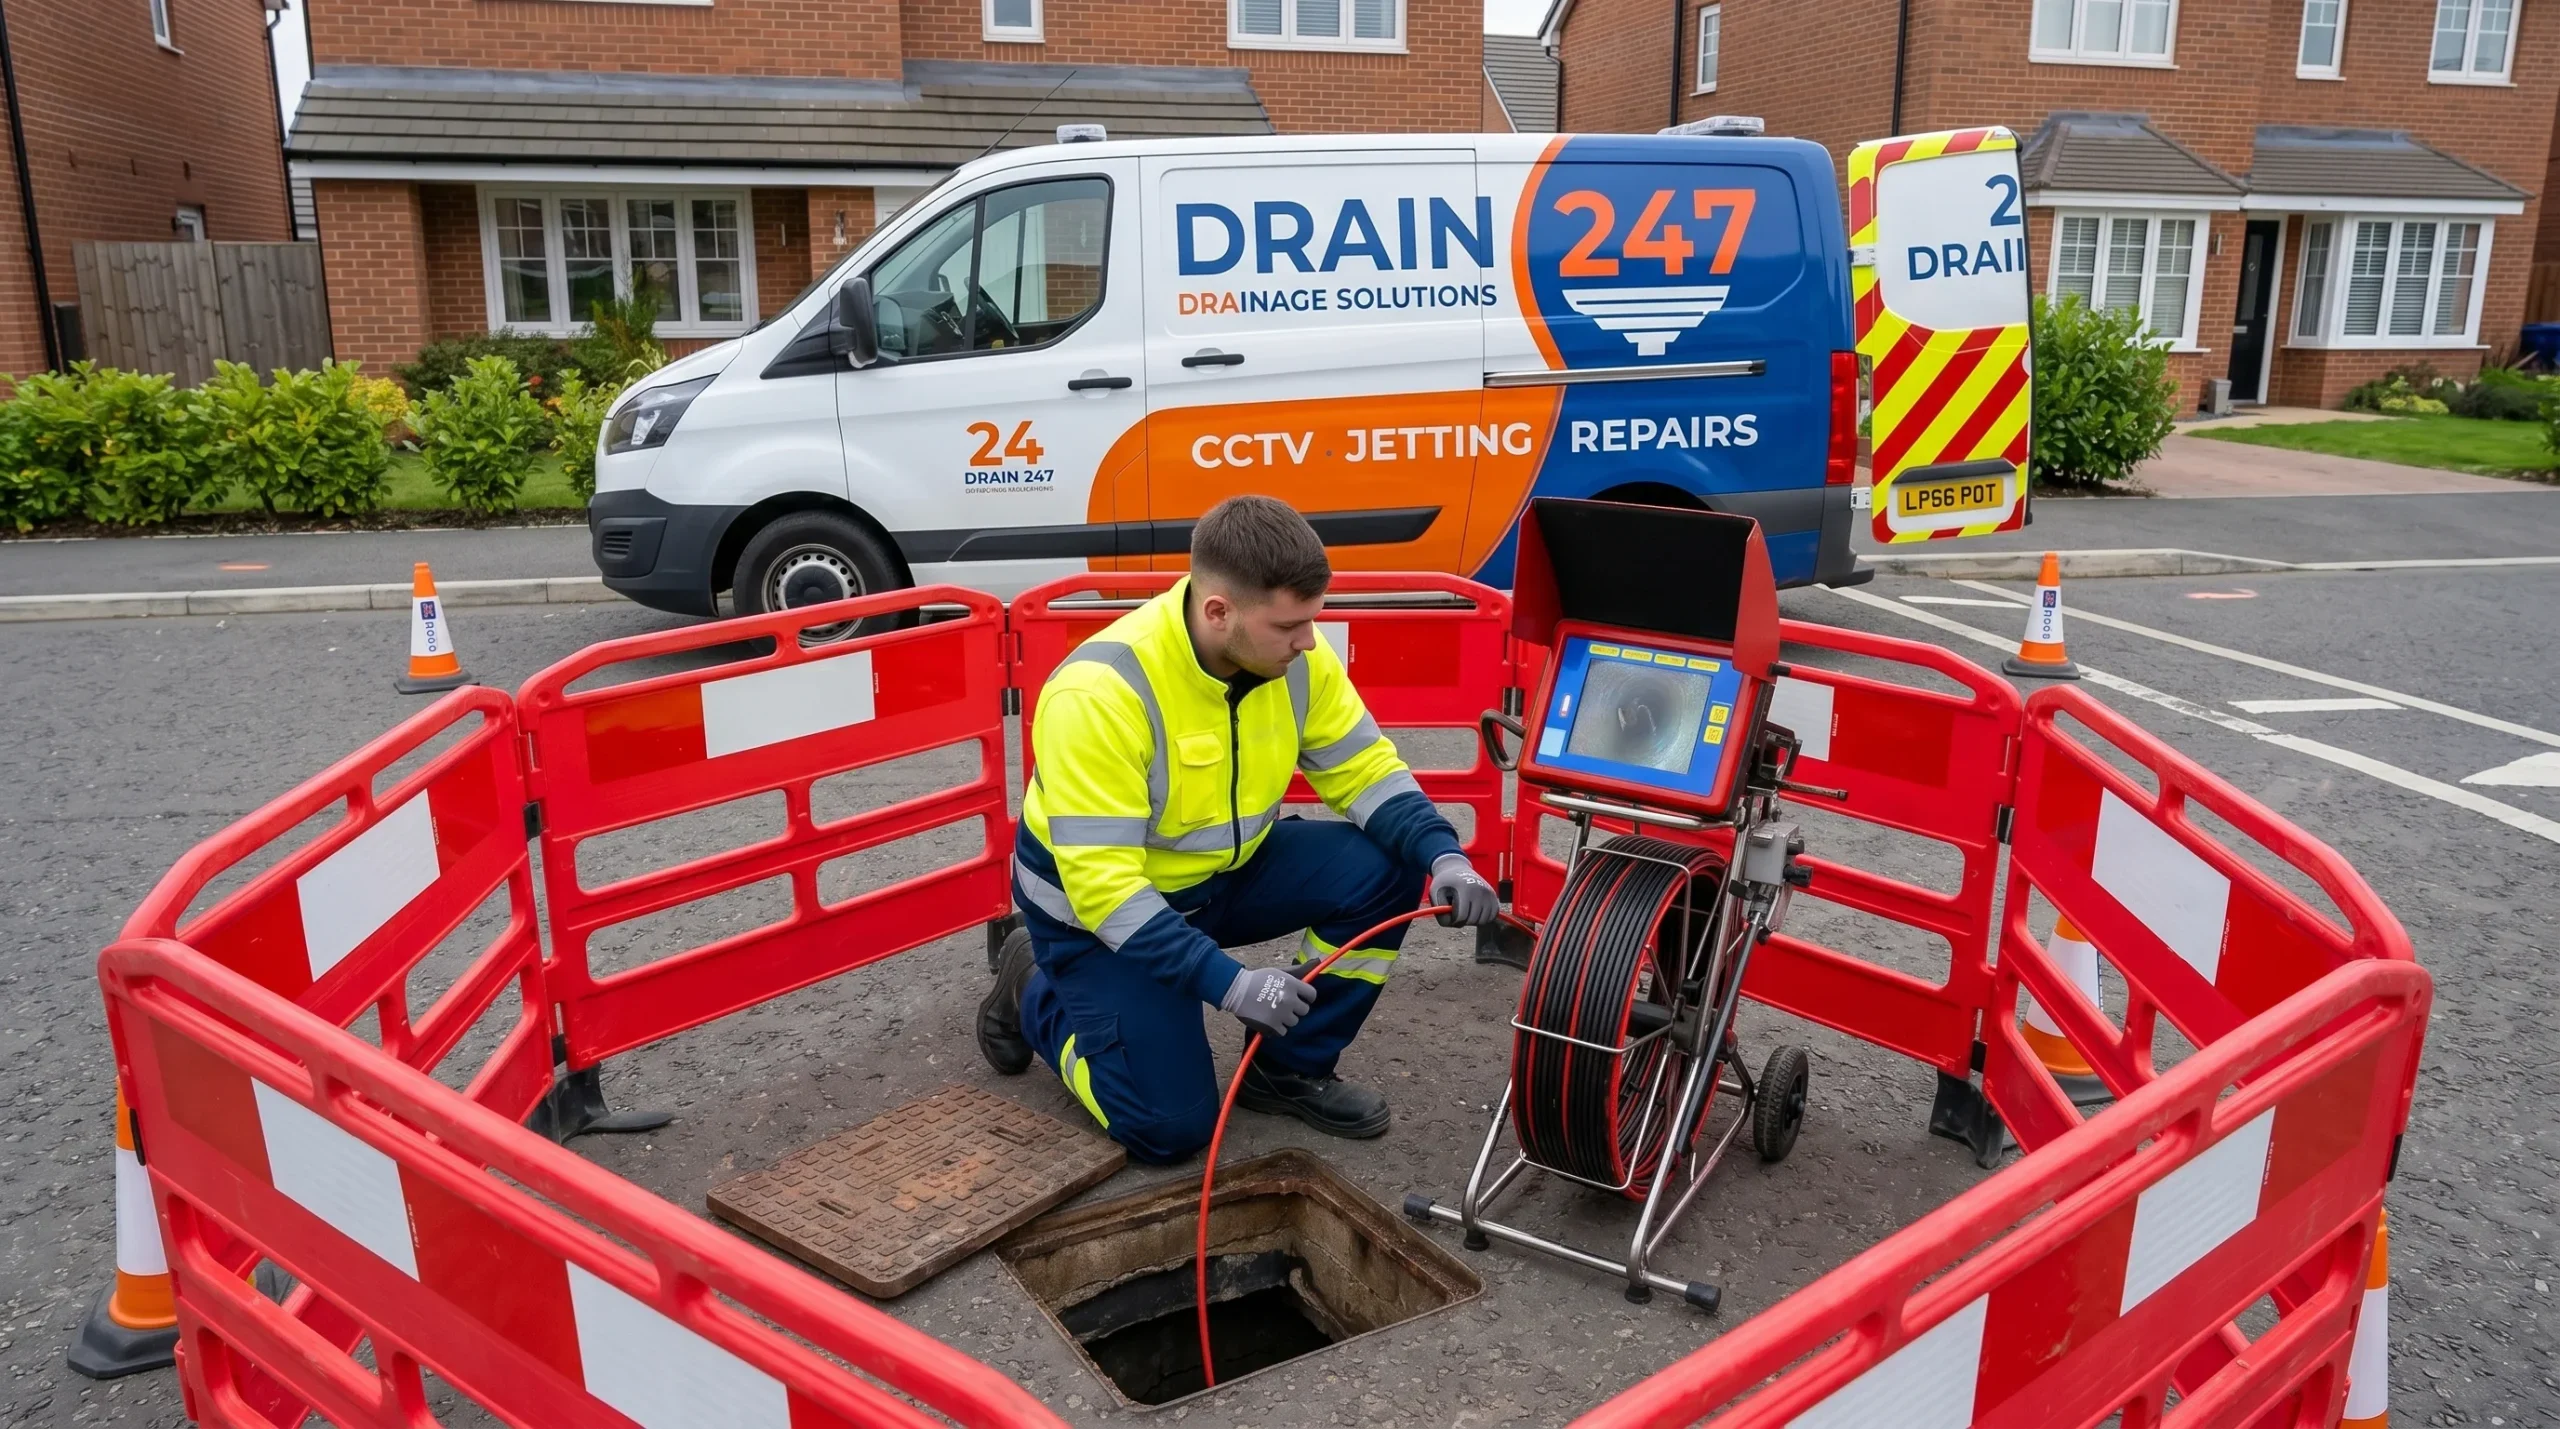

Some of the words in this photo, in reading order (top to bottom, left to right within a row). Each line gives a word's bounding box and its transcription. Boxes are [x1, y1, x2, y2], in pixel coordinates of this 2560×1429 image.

[1985, 174, 2021, 226] 2
[1176, 196, 1495, 277] DRAIN
[1553, 189, 1756, 277] 247
[1178, 288, 1328, 315] DRAINAGE
[1336, 284, 1498, 311] SOLUTIONS
[966, 420, 1044, 467] 24
[1191, 431, 1314, 469] CCTV
[1345, 422, 1532, 463] JETTING
[1571, 413, 1758, 453] REPAIRS
[965, 471, 1019, 485] DRAIN
[1023, 469, 1055, 483] 247
[1961, 483, 1996, 505] POT
